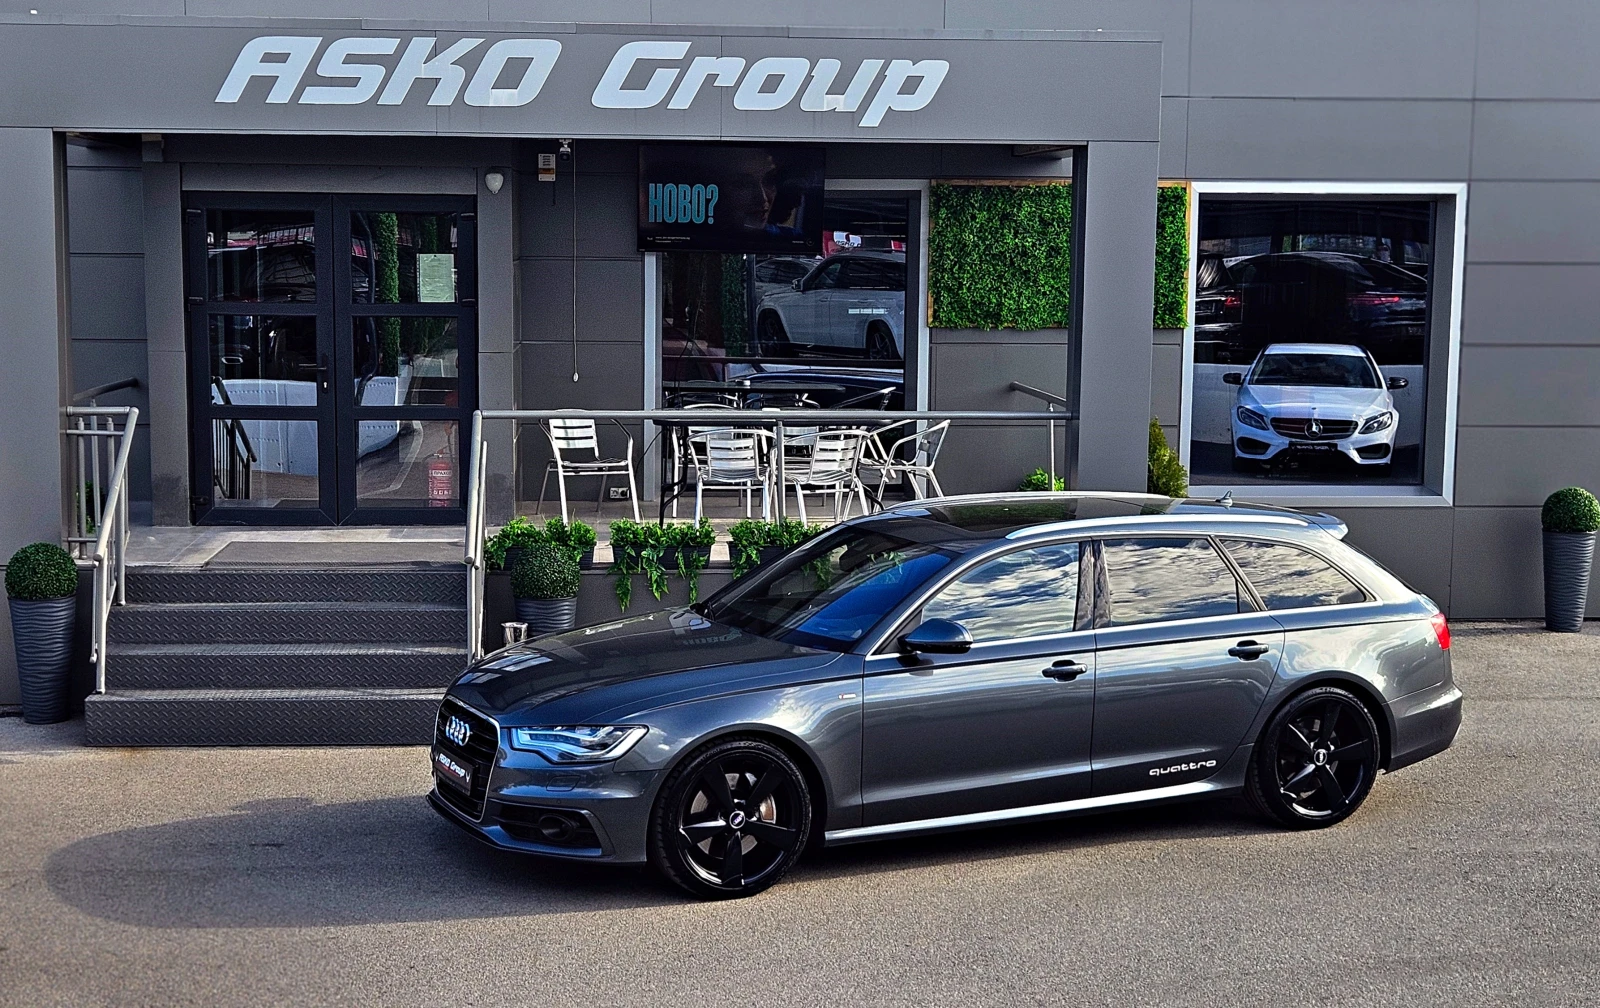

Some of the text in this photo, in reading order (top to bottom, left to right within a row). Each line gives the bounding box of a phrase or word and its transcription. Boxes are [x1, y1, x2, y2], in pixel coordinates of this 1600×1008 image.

[214, 36, 950, 127] ASKO Group
[648, 183, 719, 224] НОВО?
[1149, 760, 1217, 776] quattro
